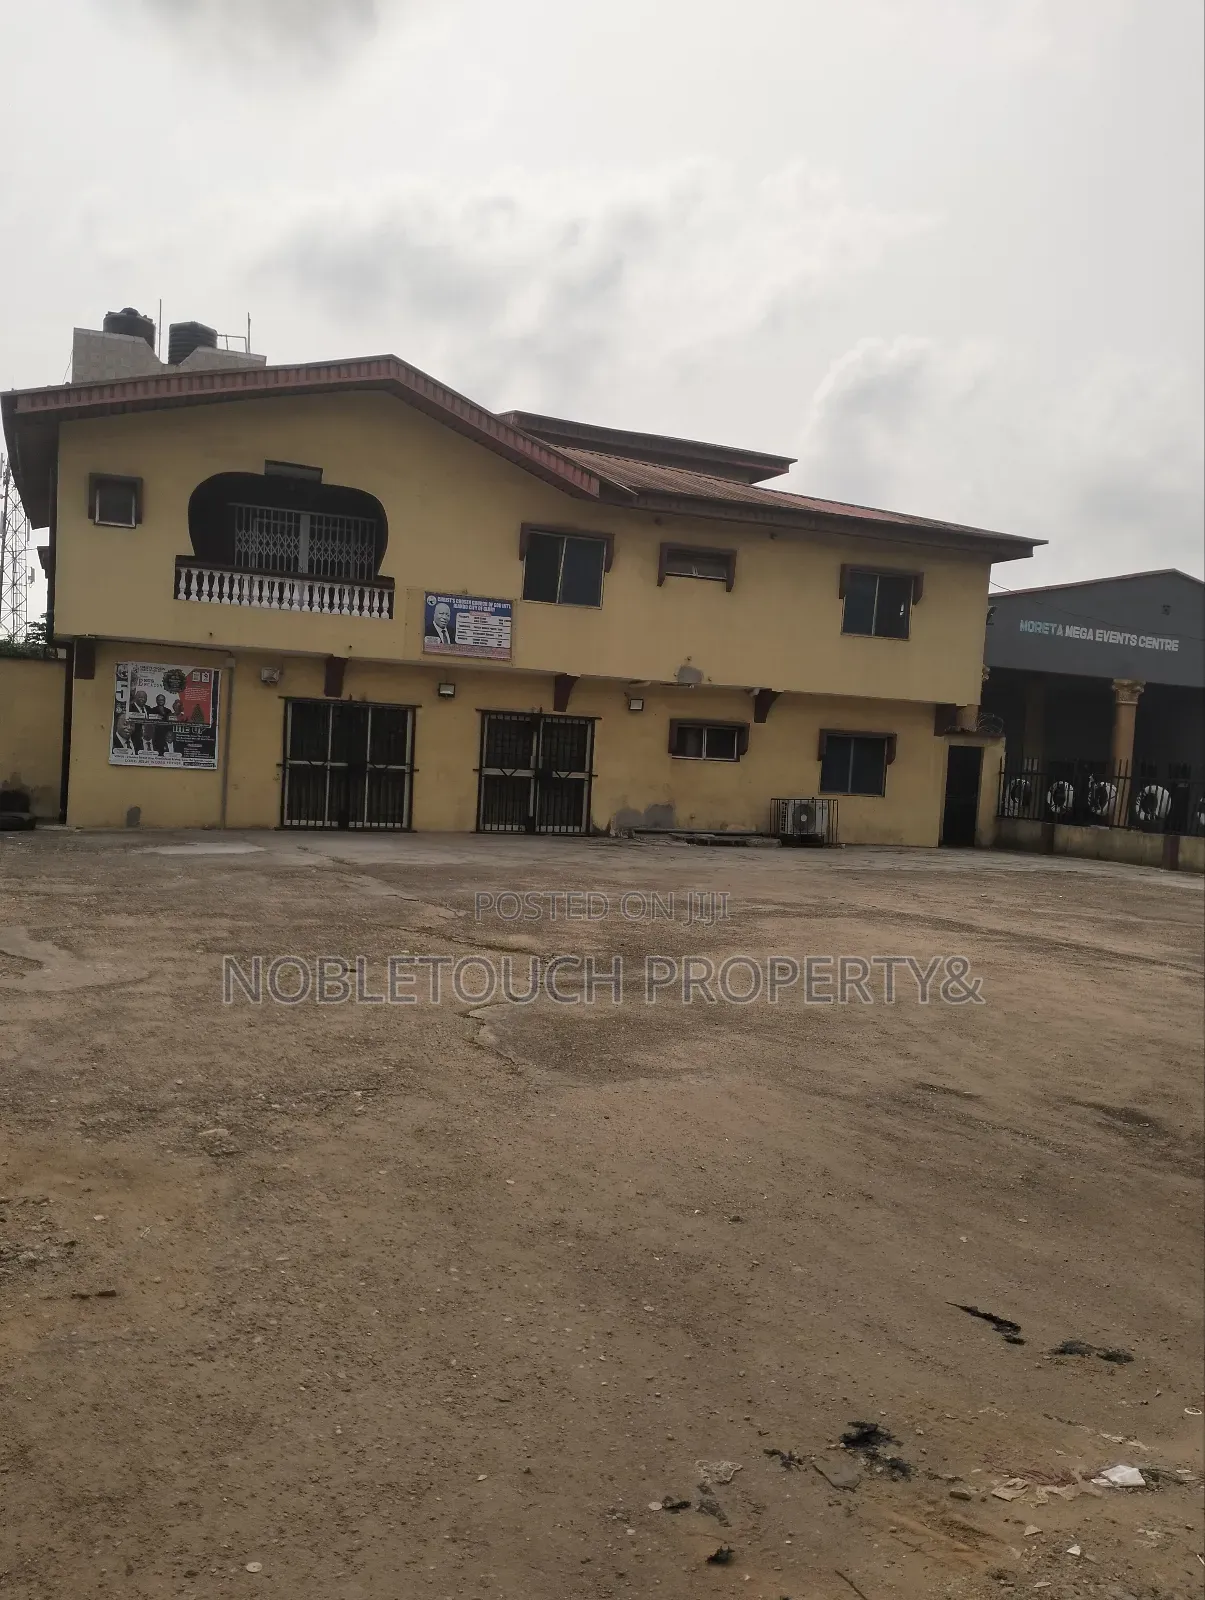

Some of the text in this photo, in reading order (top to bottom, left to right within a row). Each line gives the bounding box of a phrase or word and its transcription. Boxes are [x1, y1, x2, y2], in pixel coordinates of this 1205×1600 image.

[1065, 624, 1094, 641] MEGA
[1095, 629, 1138, 647] EVENTS
[1138, 635, 1180, 652] CENTRE
